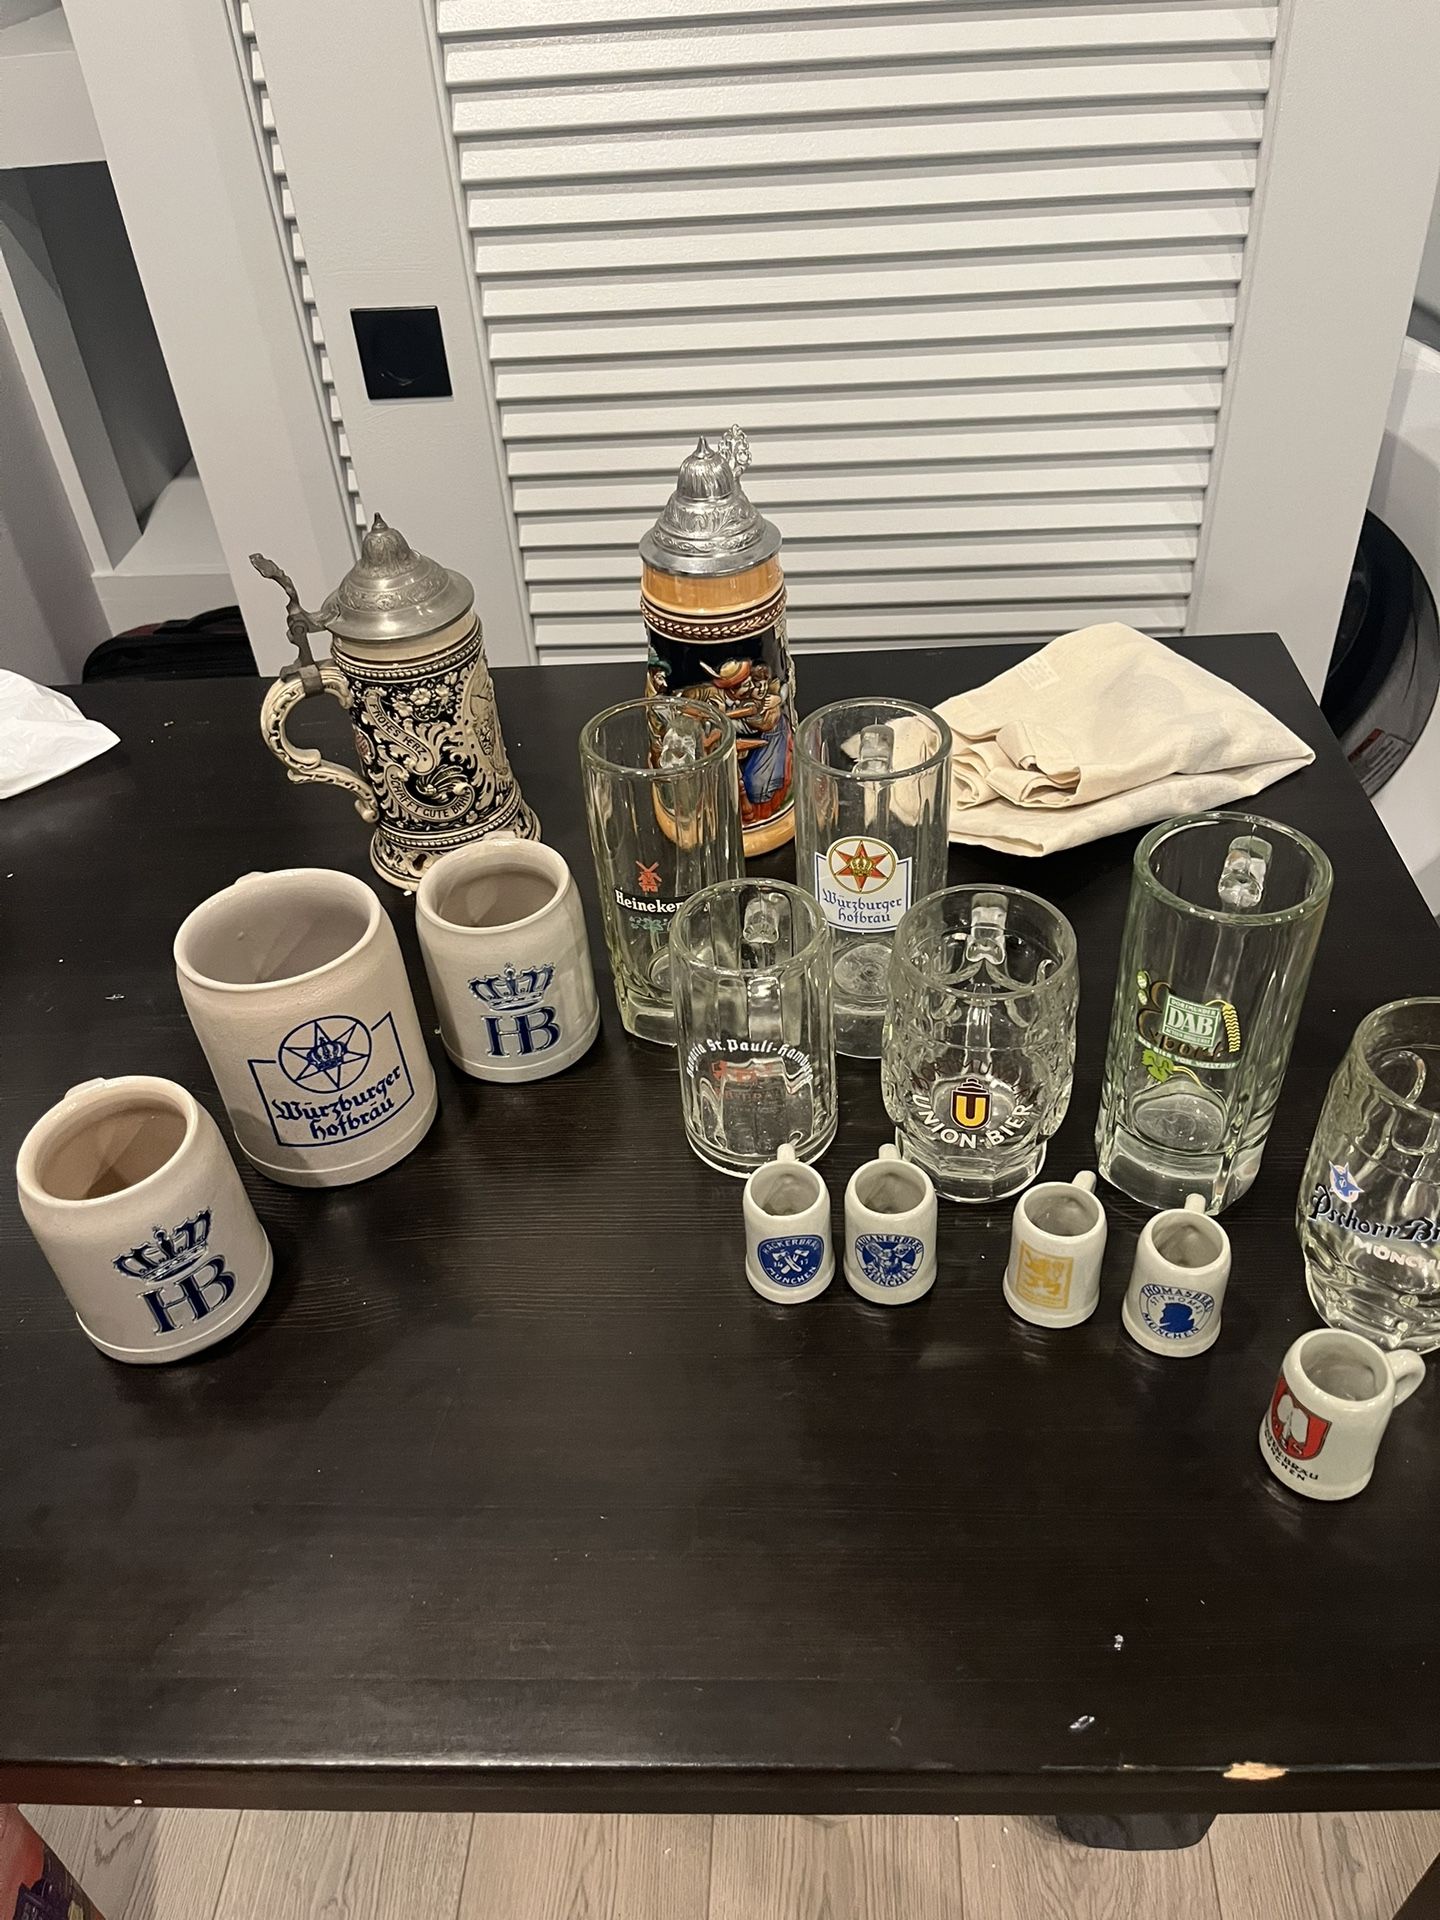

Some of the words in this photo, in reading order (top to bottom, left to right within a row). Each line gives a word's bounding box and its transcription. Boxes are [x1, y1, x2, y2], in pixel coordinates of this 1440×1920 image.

[423, 806, 449, 818] GUTE
[480, 1005, 562, 1058] HB
[1167, 1006, 1214, 1036] DAB
[706, 1038, 726, 1052] St.
[136, 1254, 238, 1336] HB
